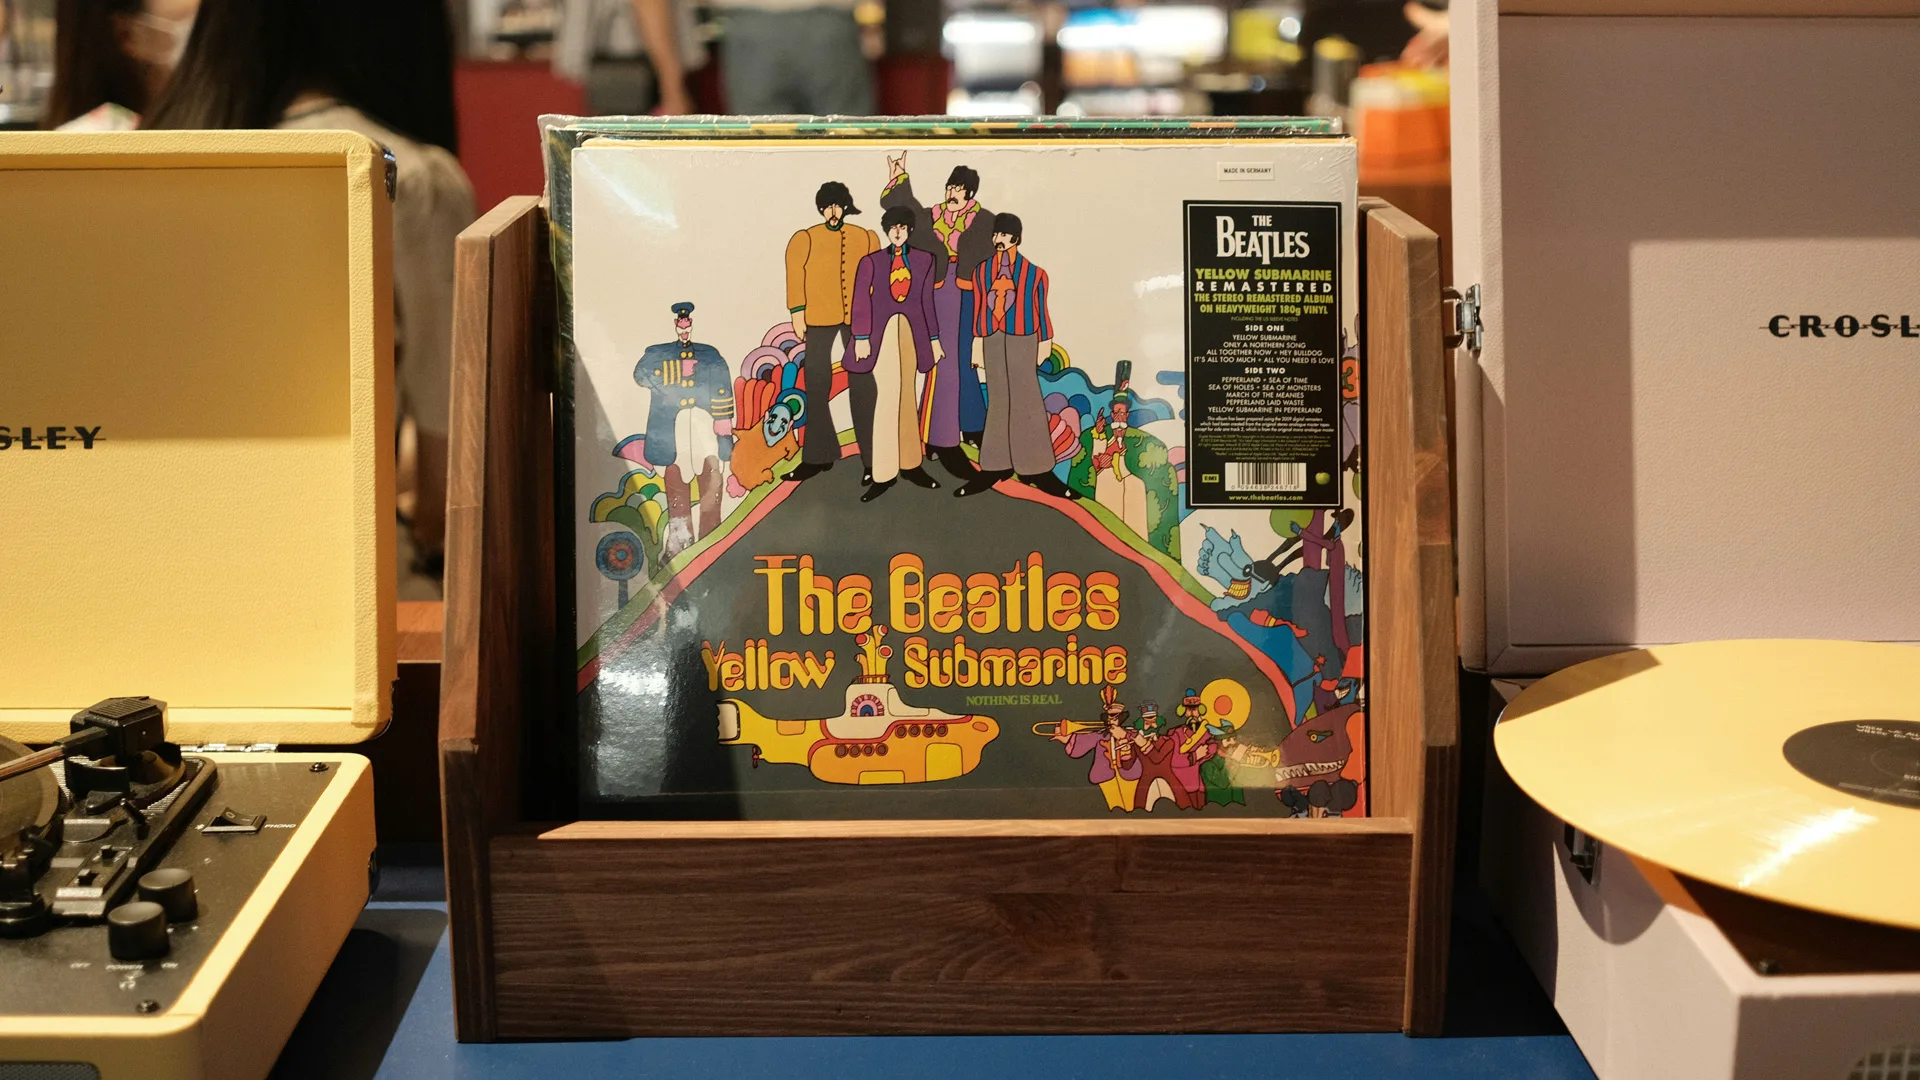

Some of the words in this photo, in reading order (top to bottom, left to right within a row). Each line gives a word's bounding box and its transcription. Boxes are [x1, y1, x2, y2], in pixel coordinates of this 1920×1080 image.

[1252, 215, 1272, 226] THE
[1216, 216, 1310, 264] BEATLES
[1195, 269, 1250, 280] YELLOW
[1254, 269, 1331, 281] SUBMARINE
[1196, 282, 1331, 292] REMASTERED
[1194, 294, 1210, 302] THE
[1212, 294, 1243, 302] STEREO
[1246, 294, 1301, 303] REMASTERED
[1304, 295, 1333, 303] ALBUM
[1200, 304, 1213, 313] ON
[1216, 305, 1276, 313] HEAVYWEIGHT
[1280, 305, 1300, 316] 180g
[1303, 306, 1328, 314] VINYL
[1766, 315, 1920, 337] CROSL
[753, 554, 873, 636] The
[888, 551, 1121, 635] Beatles
[701, 638, 836, 692] Yellow
[903, 634, 1127, 689] Submarine
[966, 696, 1017, 705] NOTHING
[1020, 695, 1030, 704] IS
[1032, 694, 1062, 704] REAL
